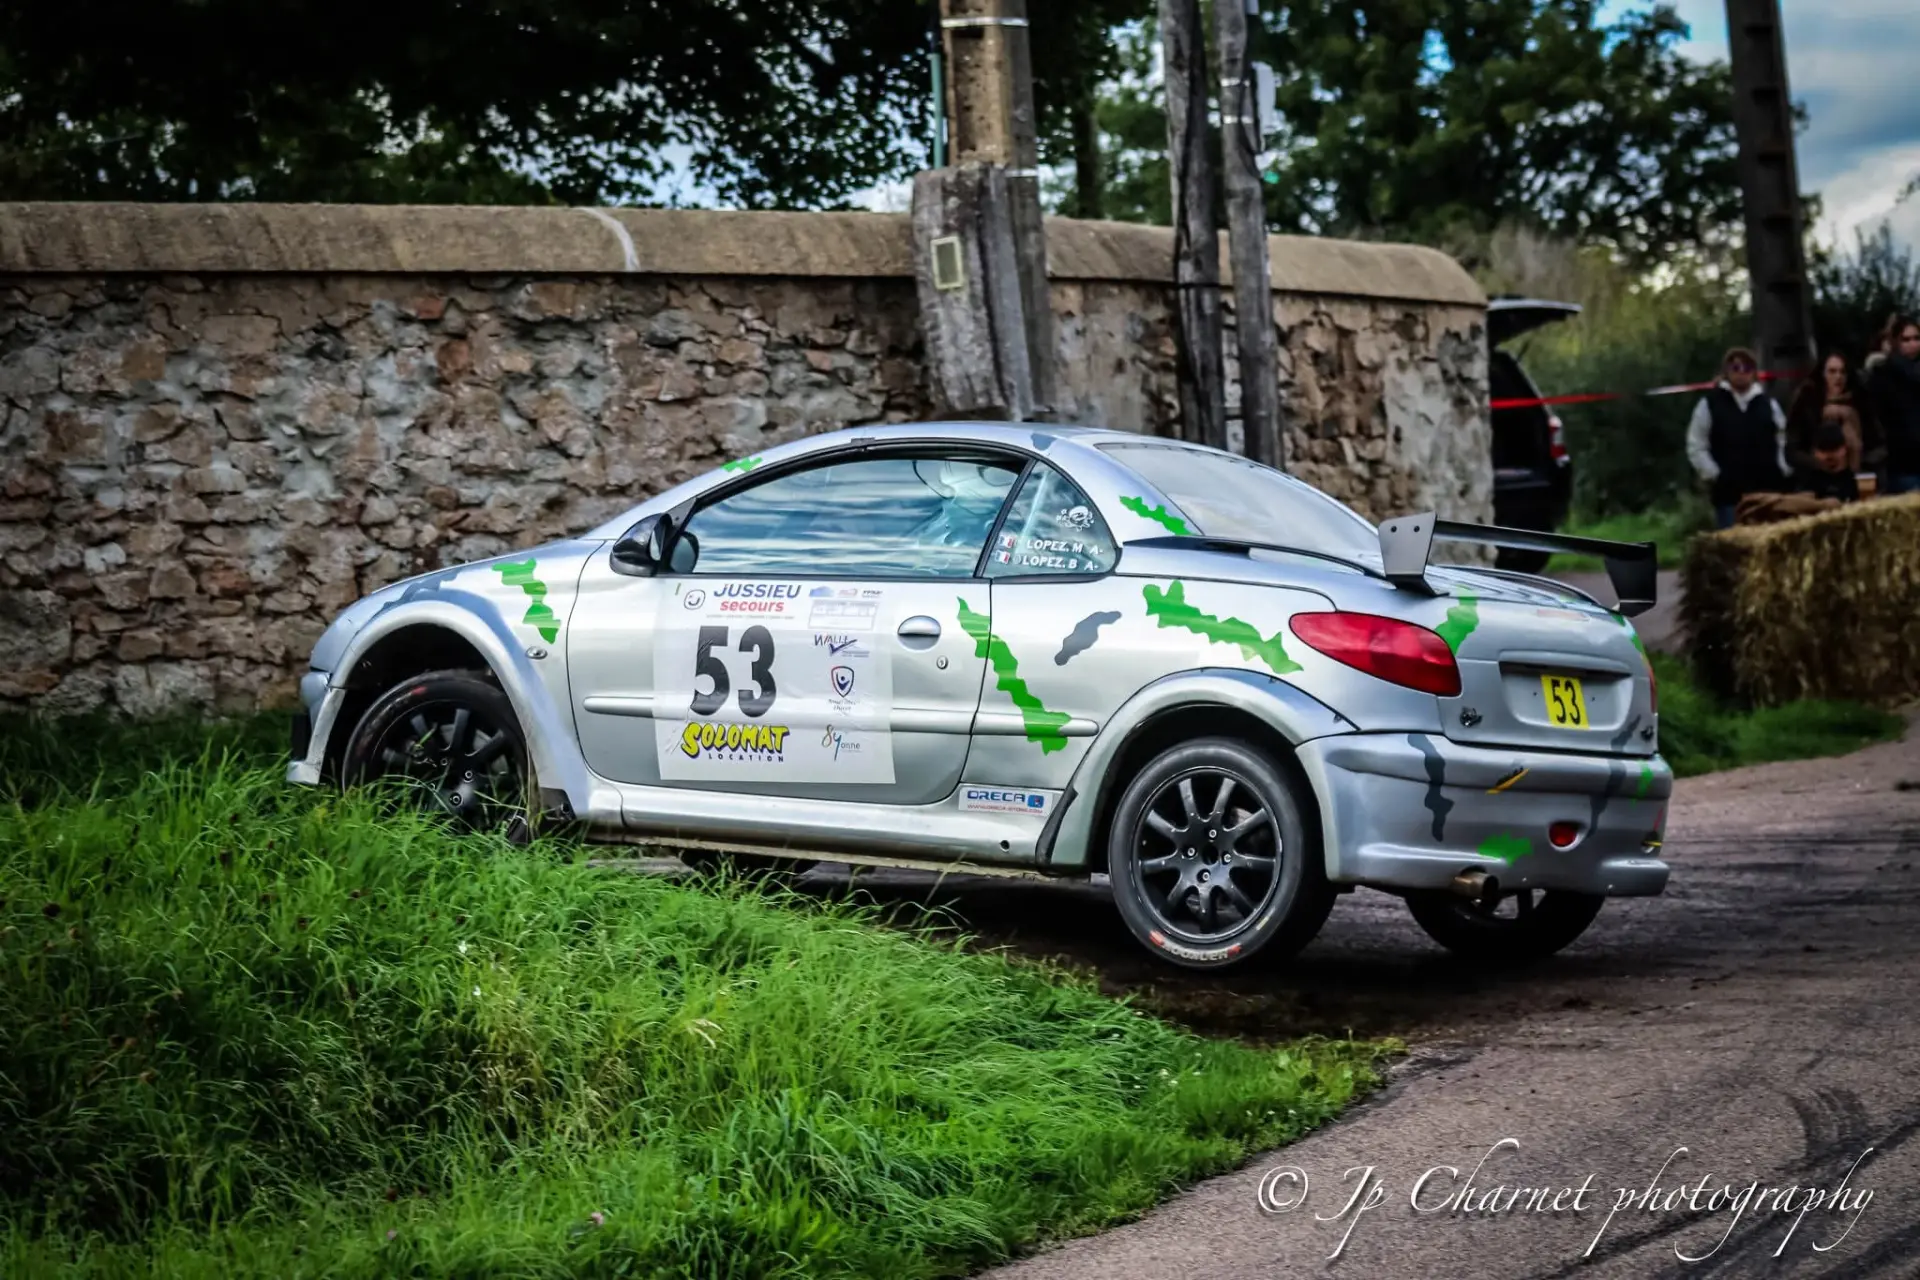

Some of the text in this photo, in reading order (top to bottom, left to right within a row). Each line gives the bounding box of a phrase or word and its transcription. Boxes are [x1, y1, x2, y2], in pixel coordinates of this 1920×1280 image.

[1072, 542, 1083, 553] M
[1068, 558, 1078, 569] B
[713, 583, 802, 599] JUSSIEU
[719, 600, 785, 612] secours
[690, 625, 777, 717] 53
[1550, 678, 1581, 725] 53
[680, 721, 790, 759] SOLOMAT
[708, 753, 785, 763] LOCATION
[967, 790, 1026, 803] ORECA
